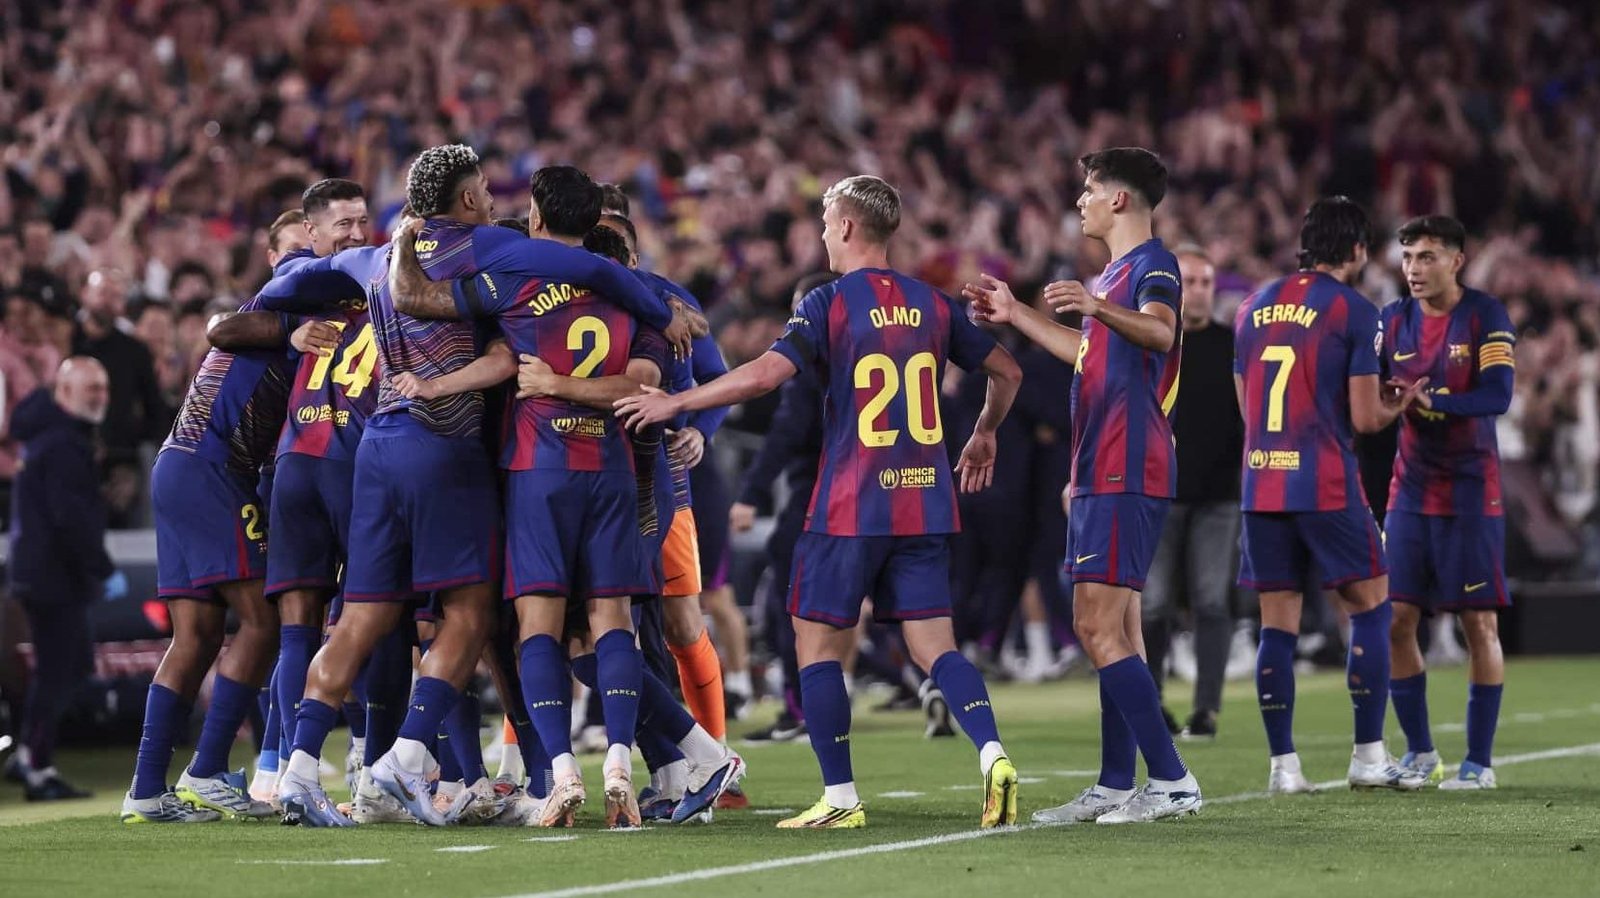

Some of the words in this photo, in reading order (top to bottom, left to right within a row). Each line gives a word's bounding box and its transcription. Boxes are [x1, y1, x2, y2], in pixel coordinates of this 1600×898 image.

[528, 283, 570, 316] JOÃO
[1253, 303, 1318, 328] FERRAN
[870, 305, 921, 329] OLMO
[306, 320, 378, 398] 14
[566, 315, 610, 379] 2
[854, 352, 943, 447] 20
[1260, 345, 1296, 432] 7
[901, 467, 935, 476] UNHCR
[901, 475, 935, 484] ACNUR
